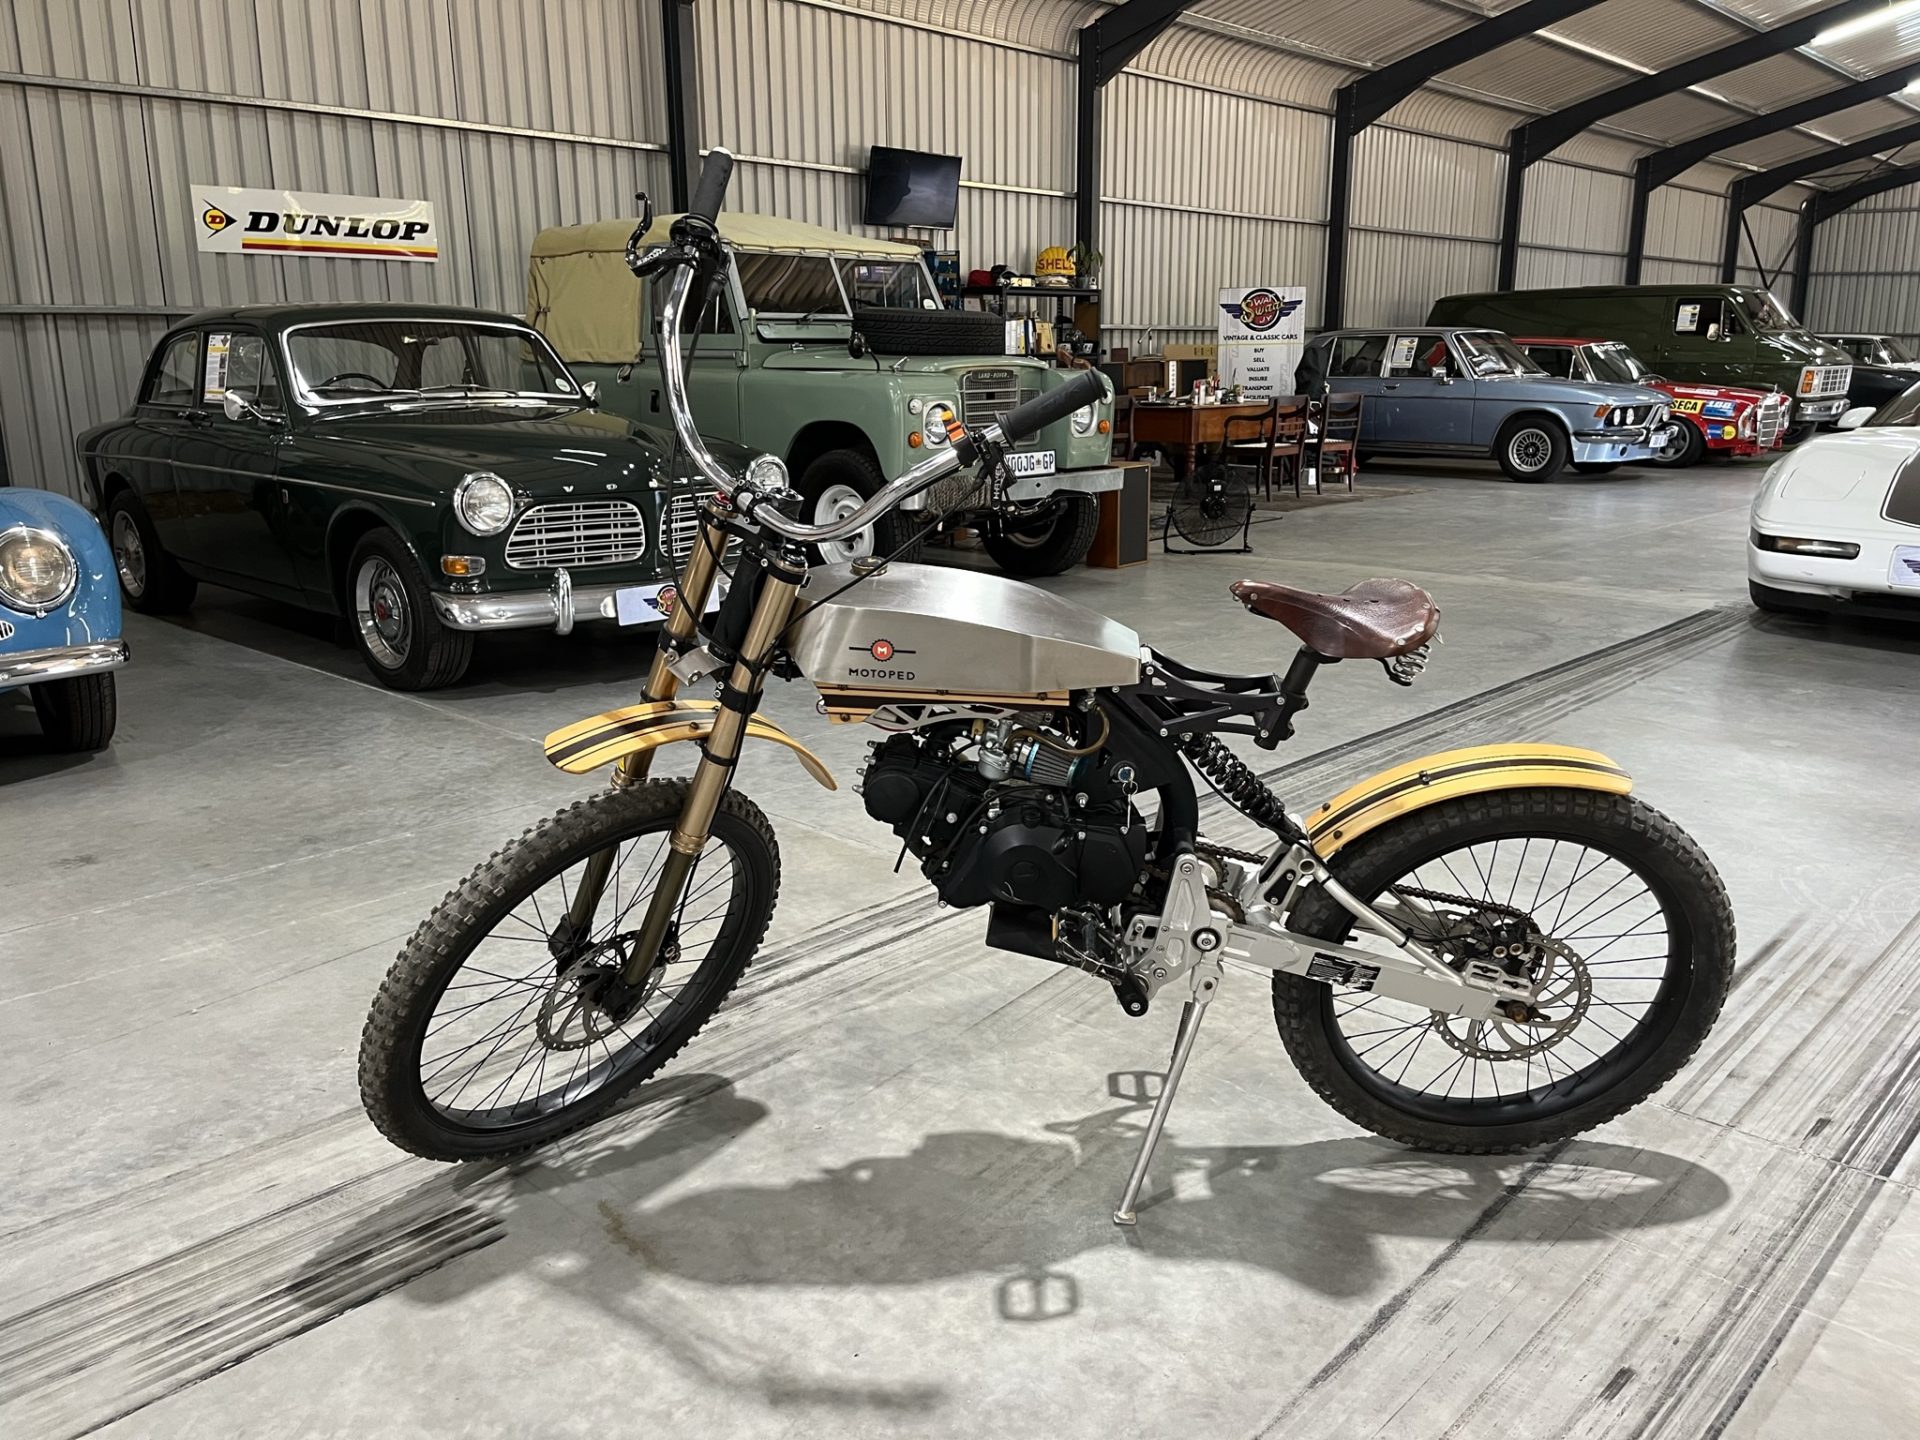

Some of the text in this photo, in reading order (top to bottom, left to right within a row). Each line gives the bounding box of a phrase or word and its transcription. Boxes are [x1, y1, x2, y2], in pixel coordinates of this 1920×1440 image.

[244, 211, 429, 241] DUNLOP
[1039, 258, 1074, 271] SHELL
[1670, 400, 1698, 411] SECA
[1042, 453, 1054, 470] GP
[877, 646, 888, 655] M
[849, 668, 916, 681] MOTOPED
